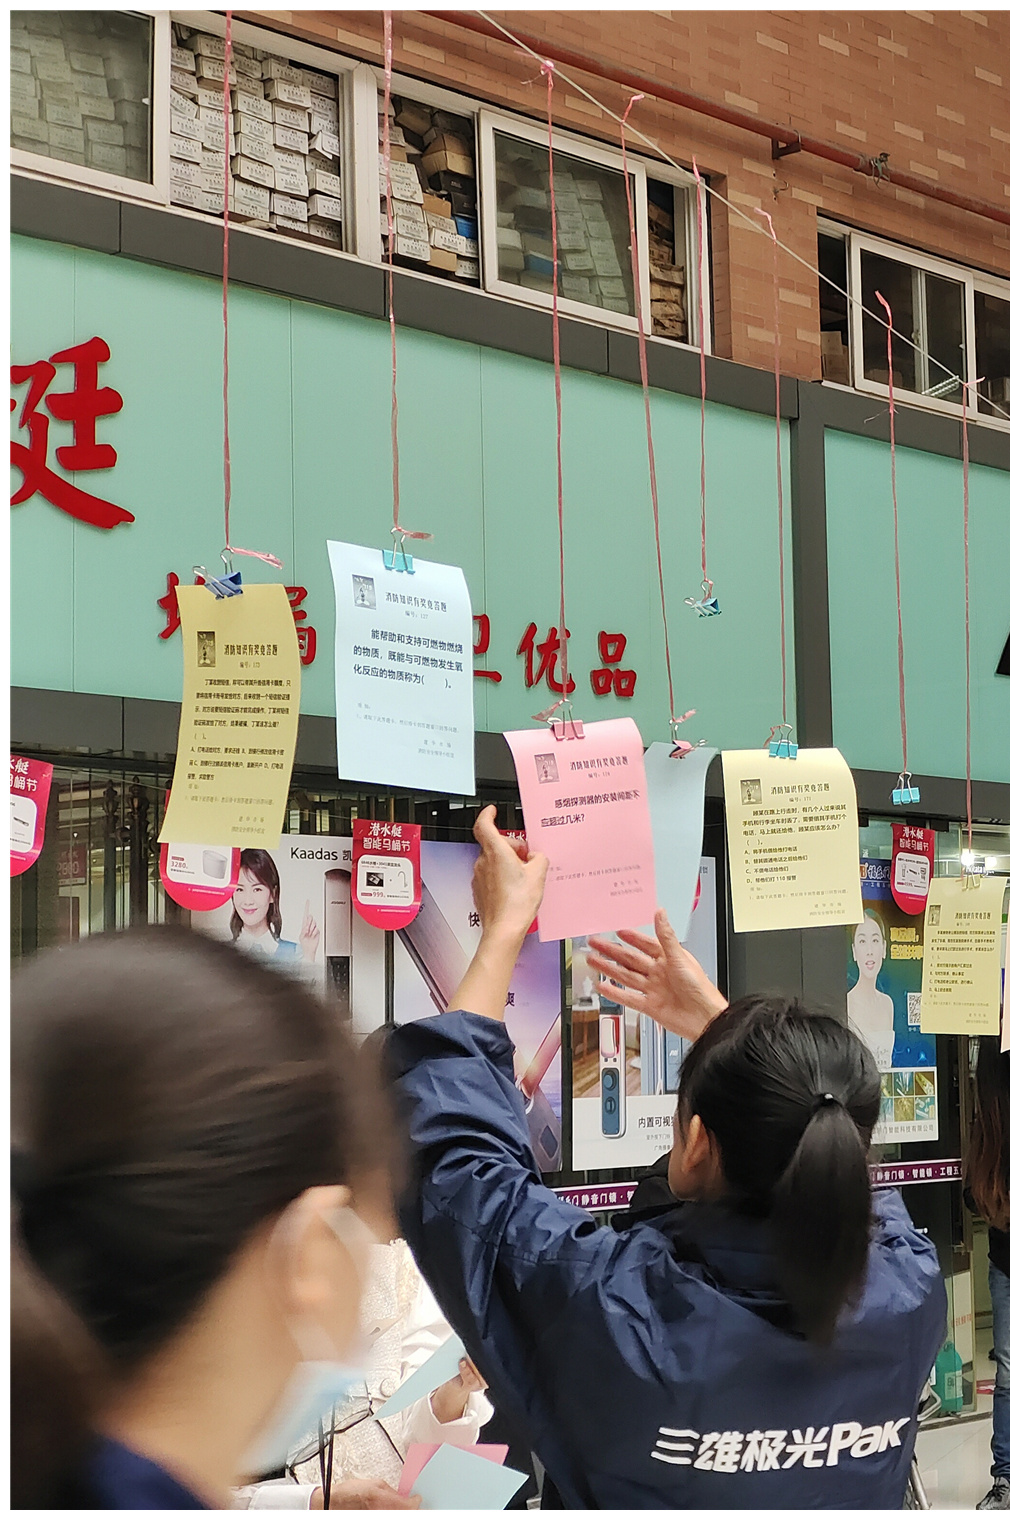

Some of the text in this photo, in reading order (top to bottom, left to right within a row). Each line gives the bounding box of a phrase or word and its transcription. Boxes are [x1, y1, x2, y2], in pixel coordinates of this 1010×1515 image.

[370, 628, 464, 655] 能帮助和支持可燃物燃烧
[369, 821, 402, 838] 潜水艇
[902, 825, 925, 840] 潜水艇
[362, 836, 411, 852] 智能马桶节
[290, 846, 339, 861] Kaadas
